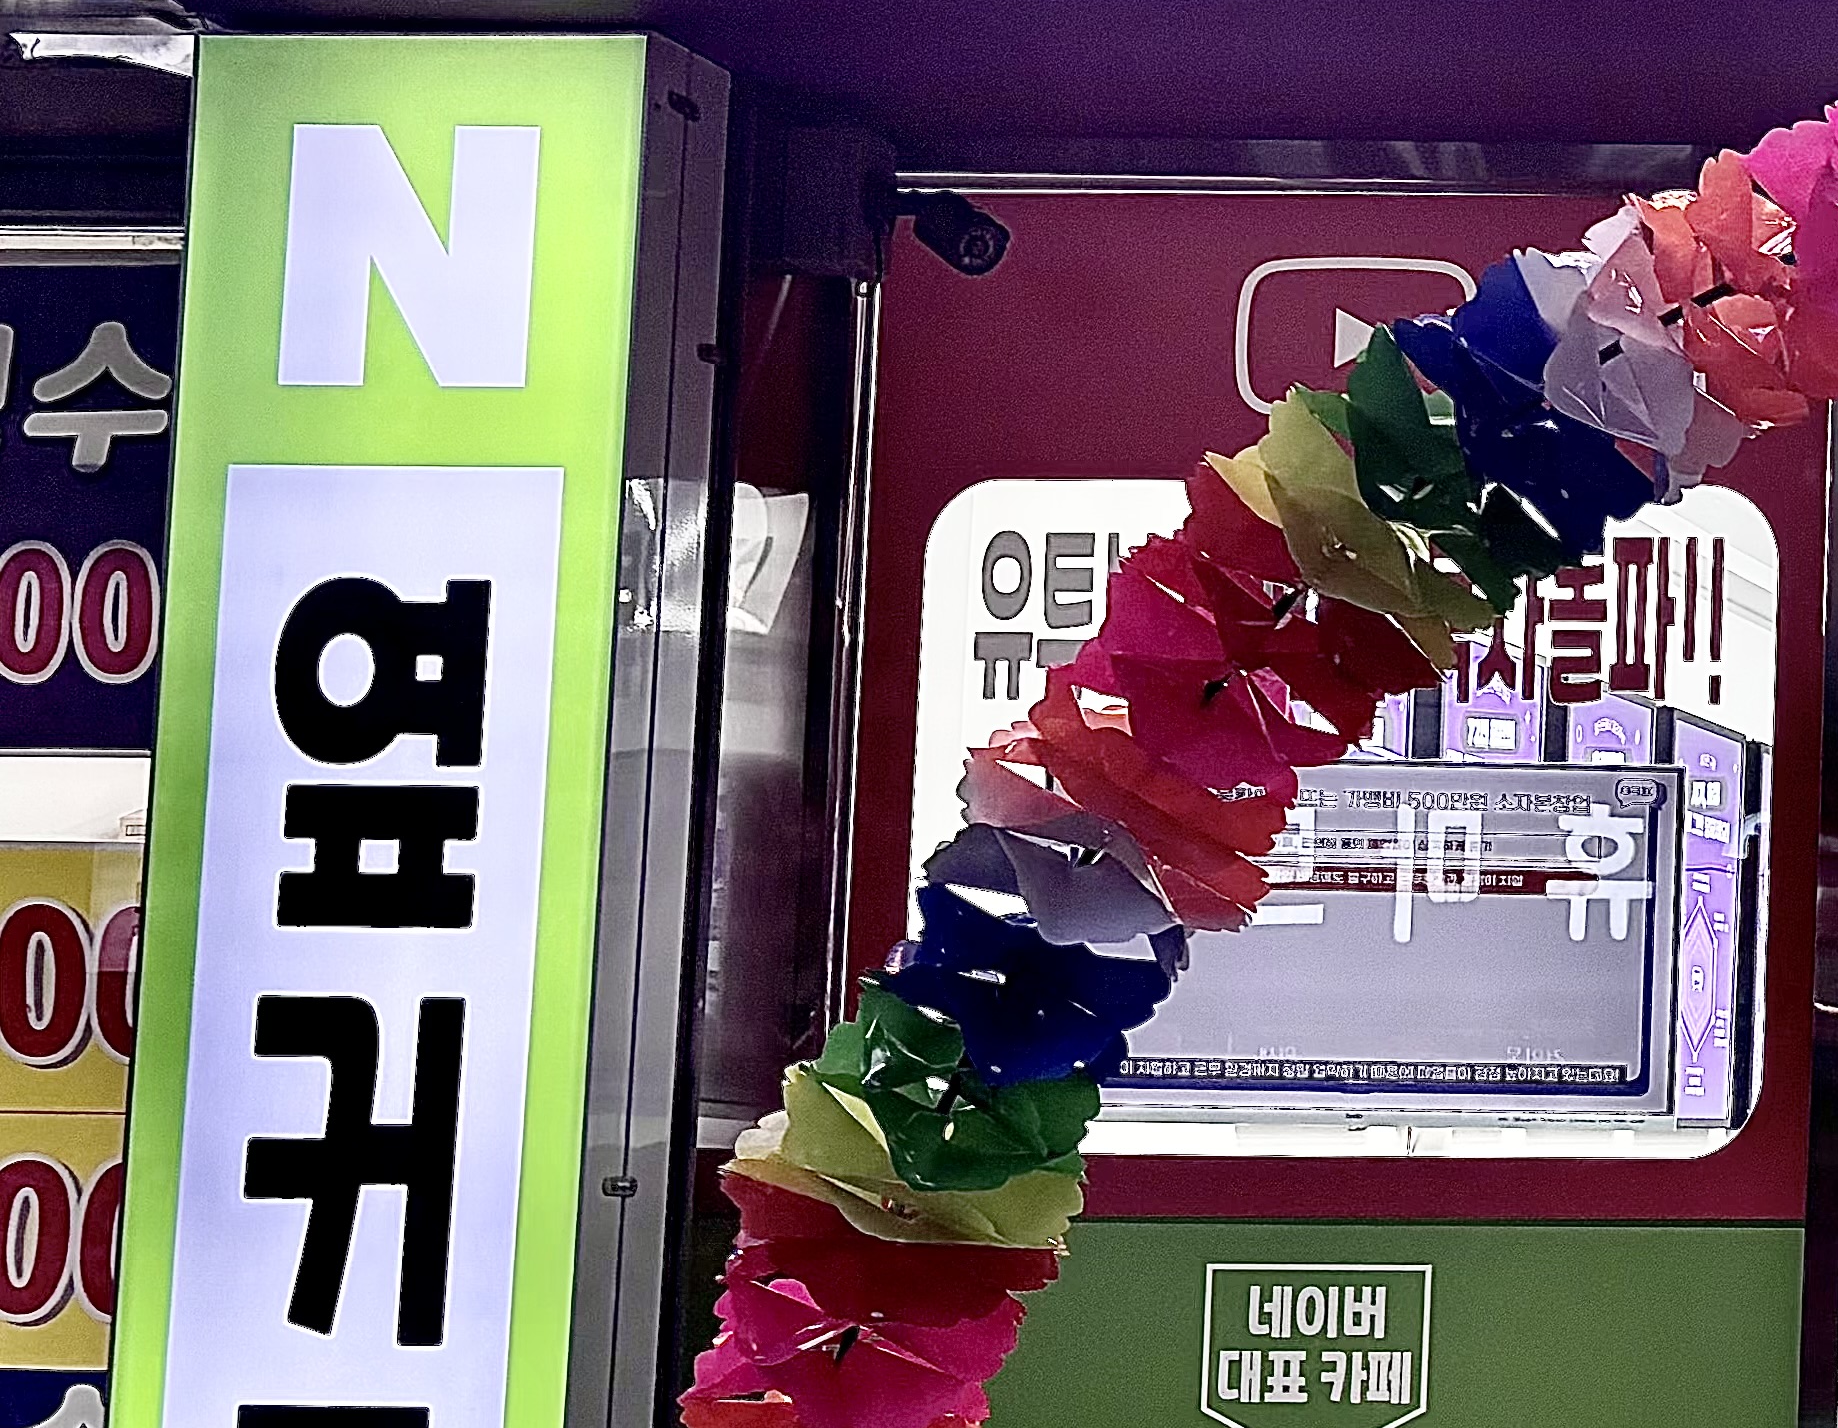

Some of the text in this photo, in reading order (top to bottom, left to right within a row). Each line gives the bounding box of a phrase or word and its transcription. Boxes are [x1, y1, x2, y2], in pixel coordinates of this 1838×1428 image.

[277, 123, 542, 388] N
[1248, 1283, 1387, 1341] 네이버
[1217, 1349, 1412, 1406] 대표 카페
